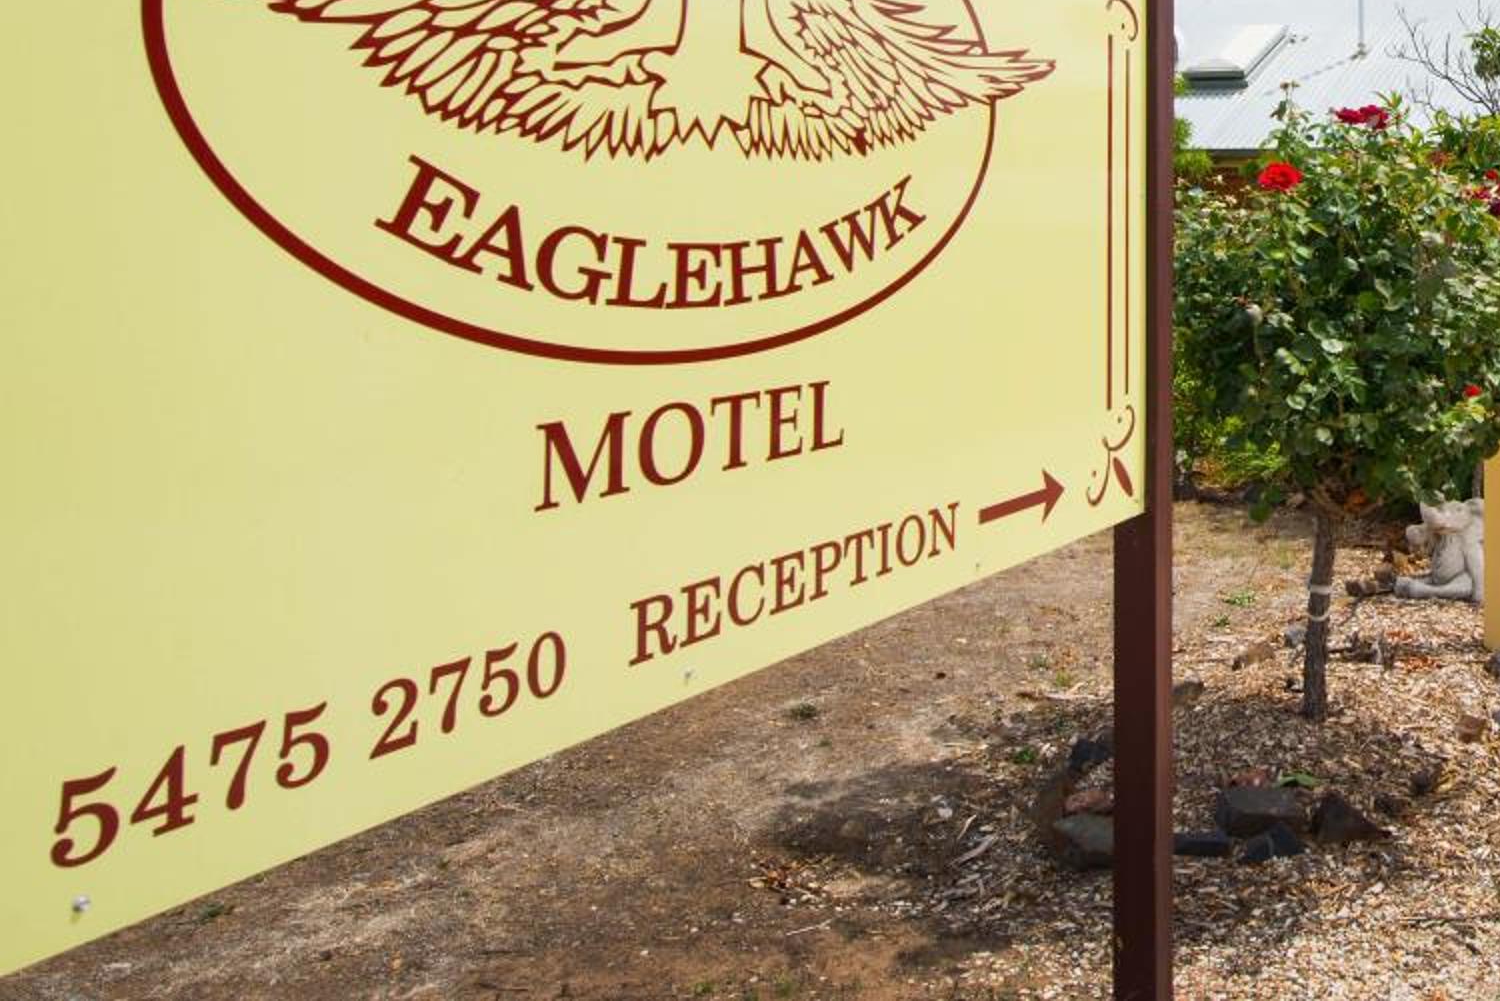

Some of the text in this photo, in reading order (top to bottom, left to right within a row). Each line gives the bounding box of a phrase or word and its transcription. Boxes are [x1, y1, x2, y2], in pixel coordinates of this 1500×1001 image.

[374, 155, 927, 310] EAGLEHAWK
[535, 380, 845, 513] MOTEL
[49, 503, 960, 869] 5475 2750 RECEPTION
